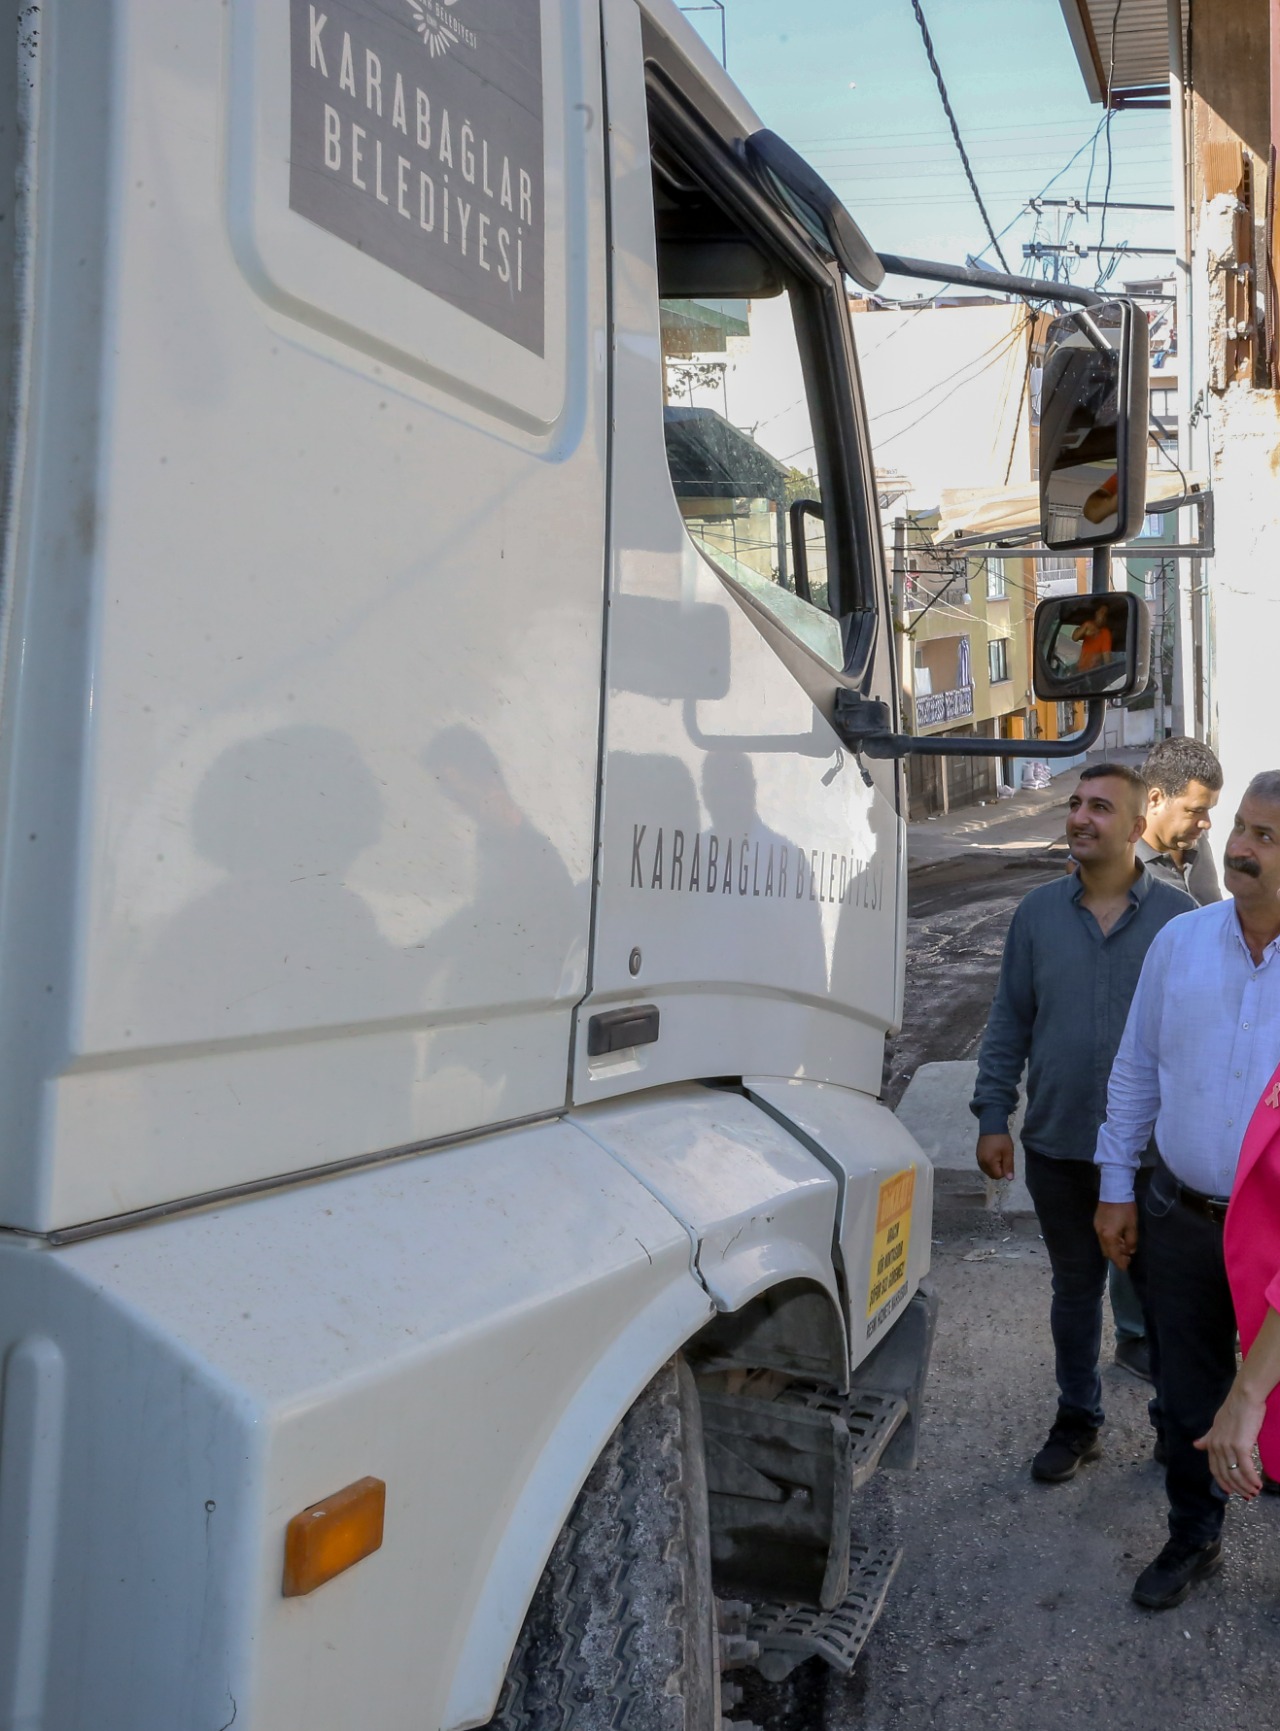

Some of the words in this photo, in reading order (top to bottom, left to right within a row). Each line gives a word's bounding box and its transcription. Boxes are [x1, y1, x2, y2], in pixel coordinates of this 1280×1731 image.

[435, 2, 477, 49] BELEDİYESİ
[310, 4, 532, 225] KARABAĞLAR
[324, 104, 522, 291] BELEDİYESİ
[631, 823, 788, 898] KARABAĞLAR
[796, 846, 884, 911] BELEDİYESİ
